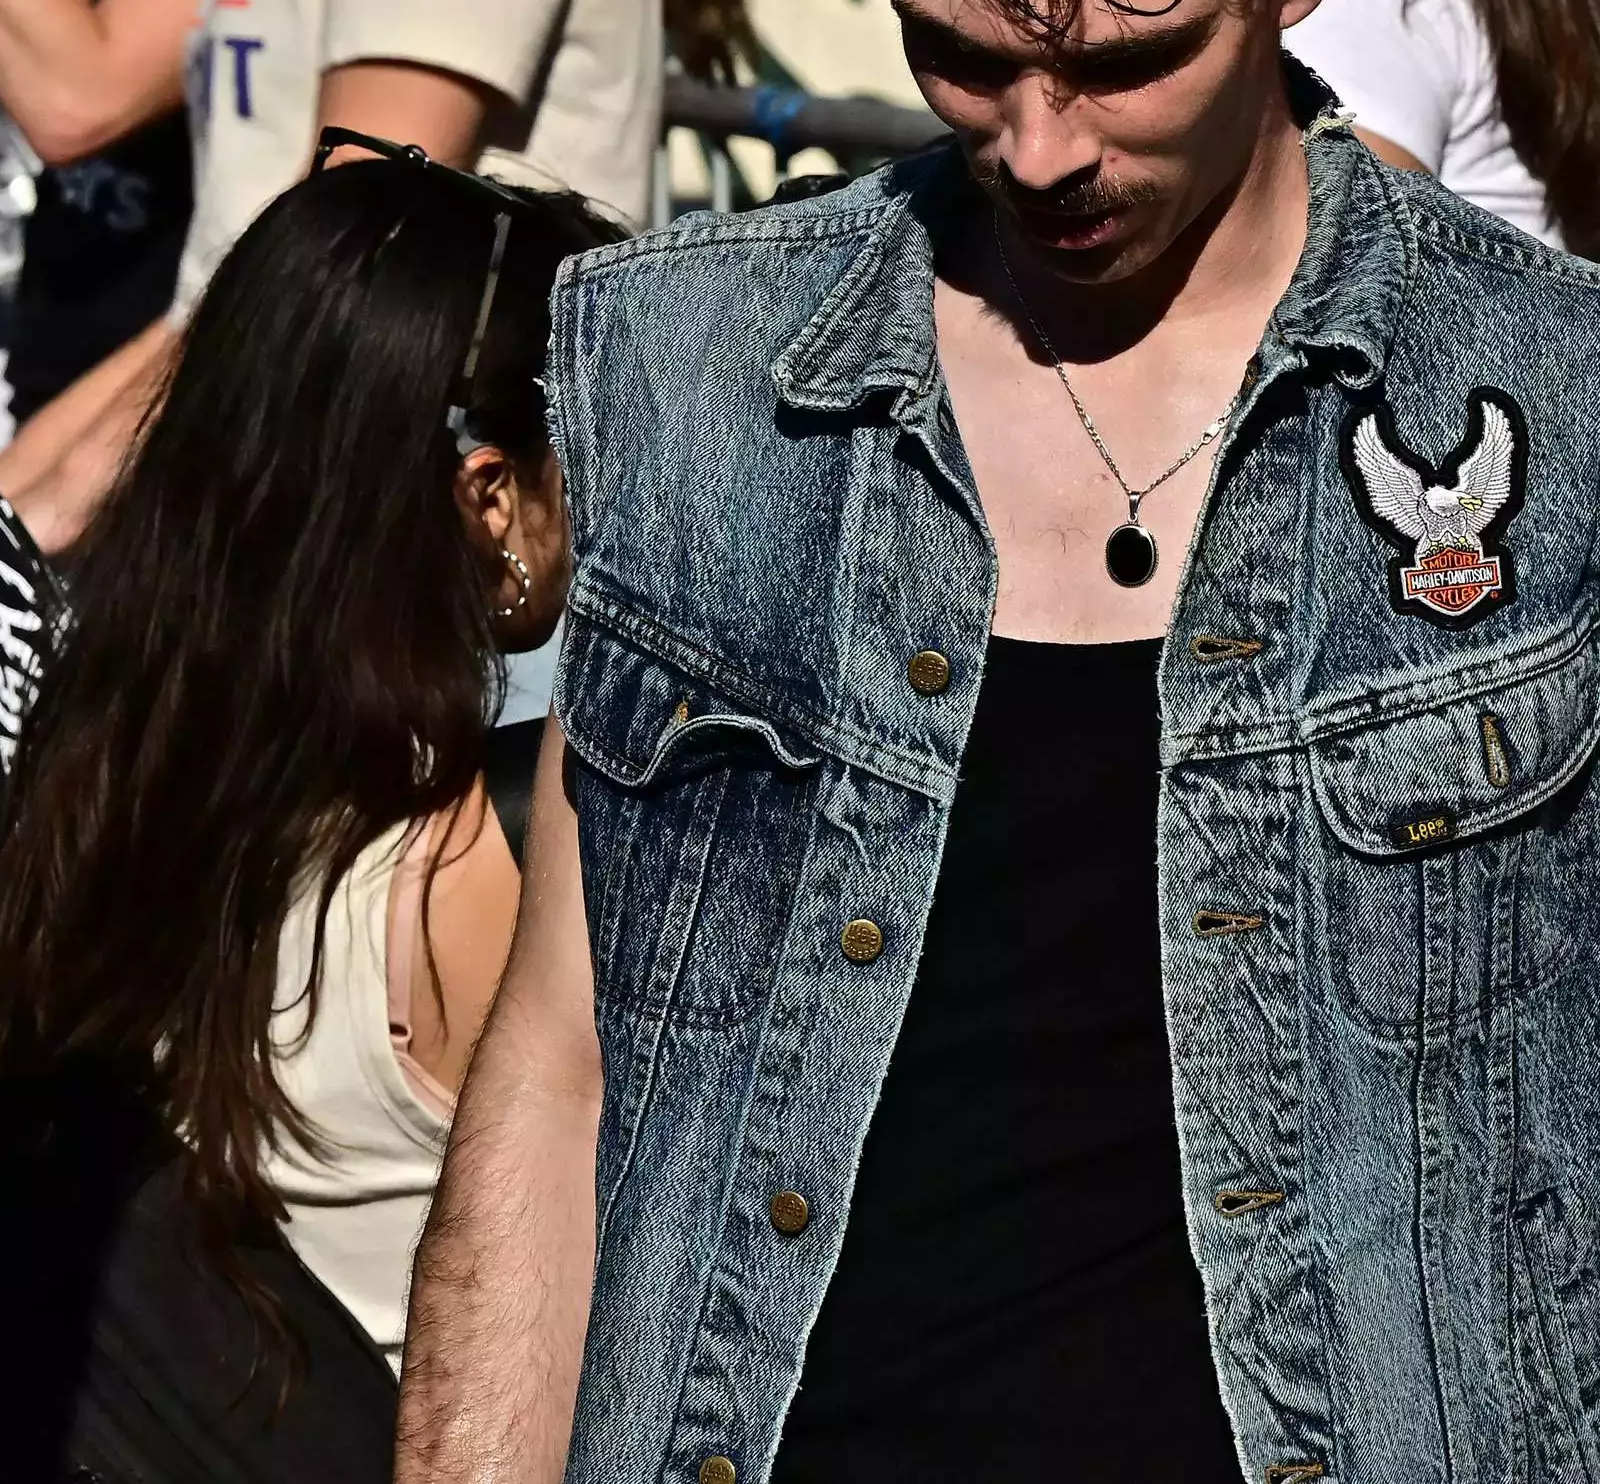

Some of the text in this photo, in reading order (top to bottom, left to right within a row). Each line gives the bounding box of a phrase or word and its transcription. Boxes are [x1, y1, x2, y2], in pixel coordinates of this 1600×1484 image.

[1429, 552, 1472, 570] MOTOR
[1411, 566, 1493, 590] HARLEY-DAVIDSON
[1433, 586, 1475, 605] CYCLES
[1408, 821, 1436, 841] Lee
